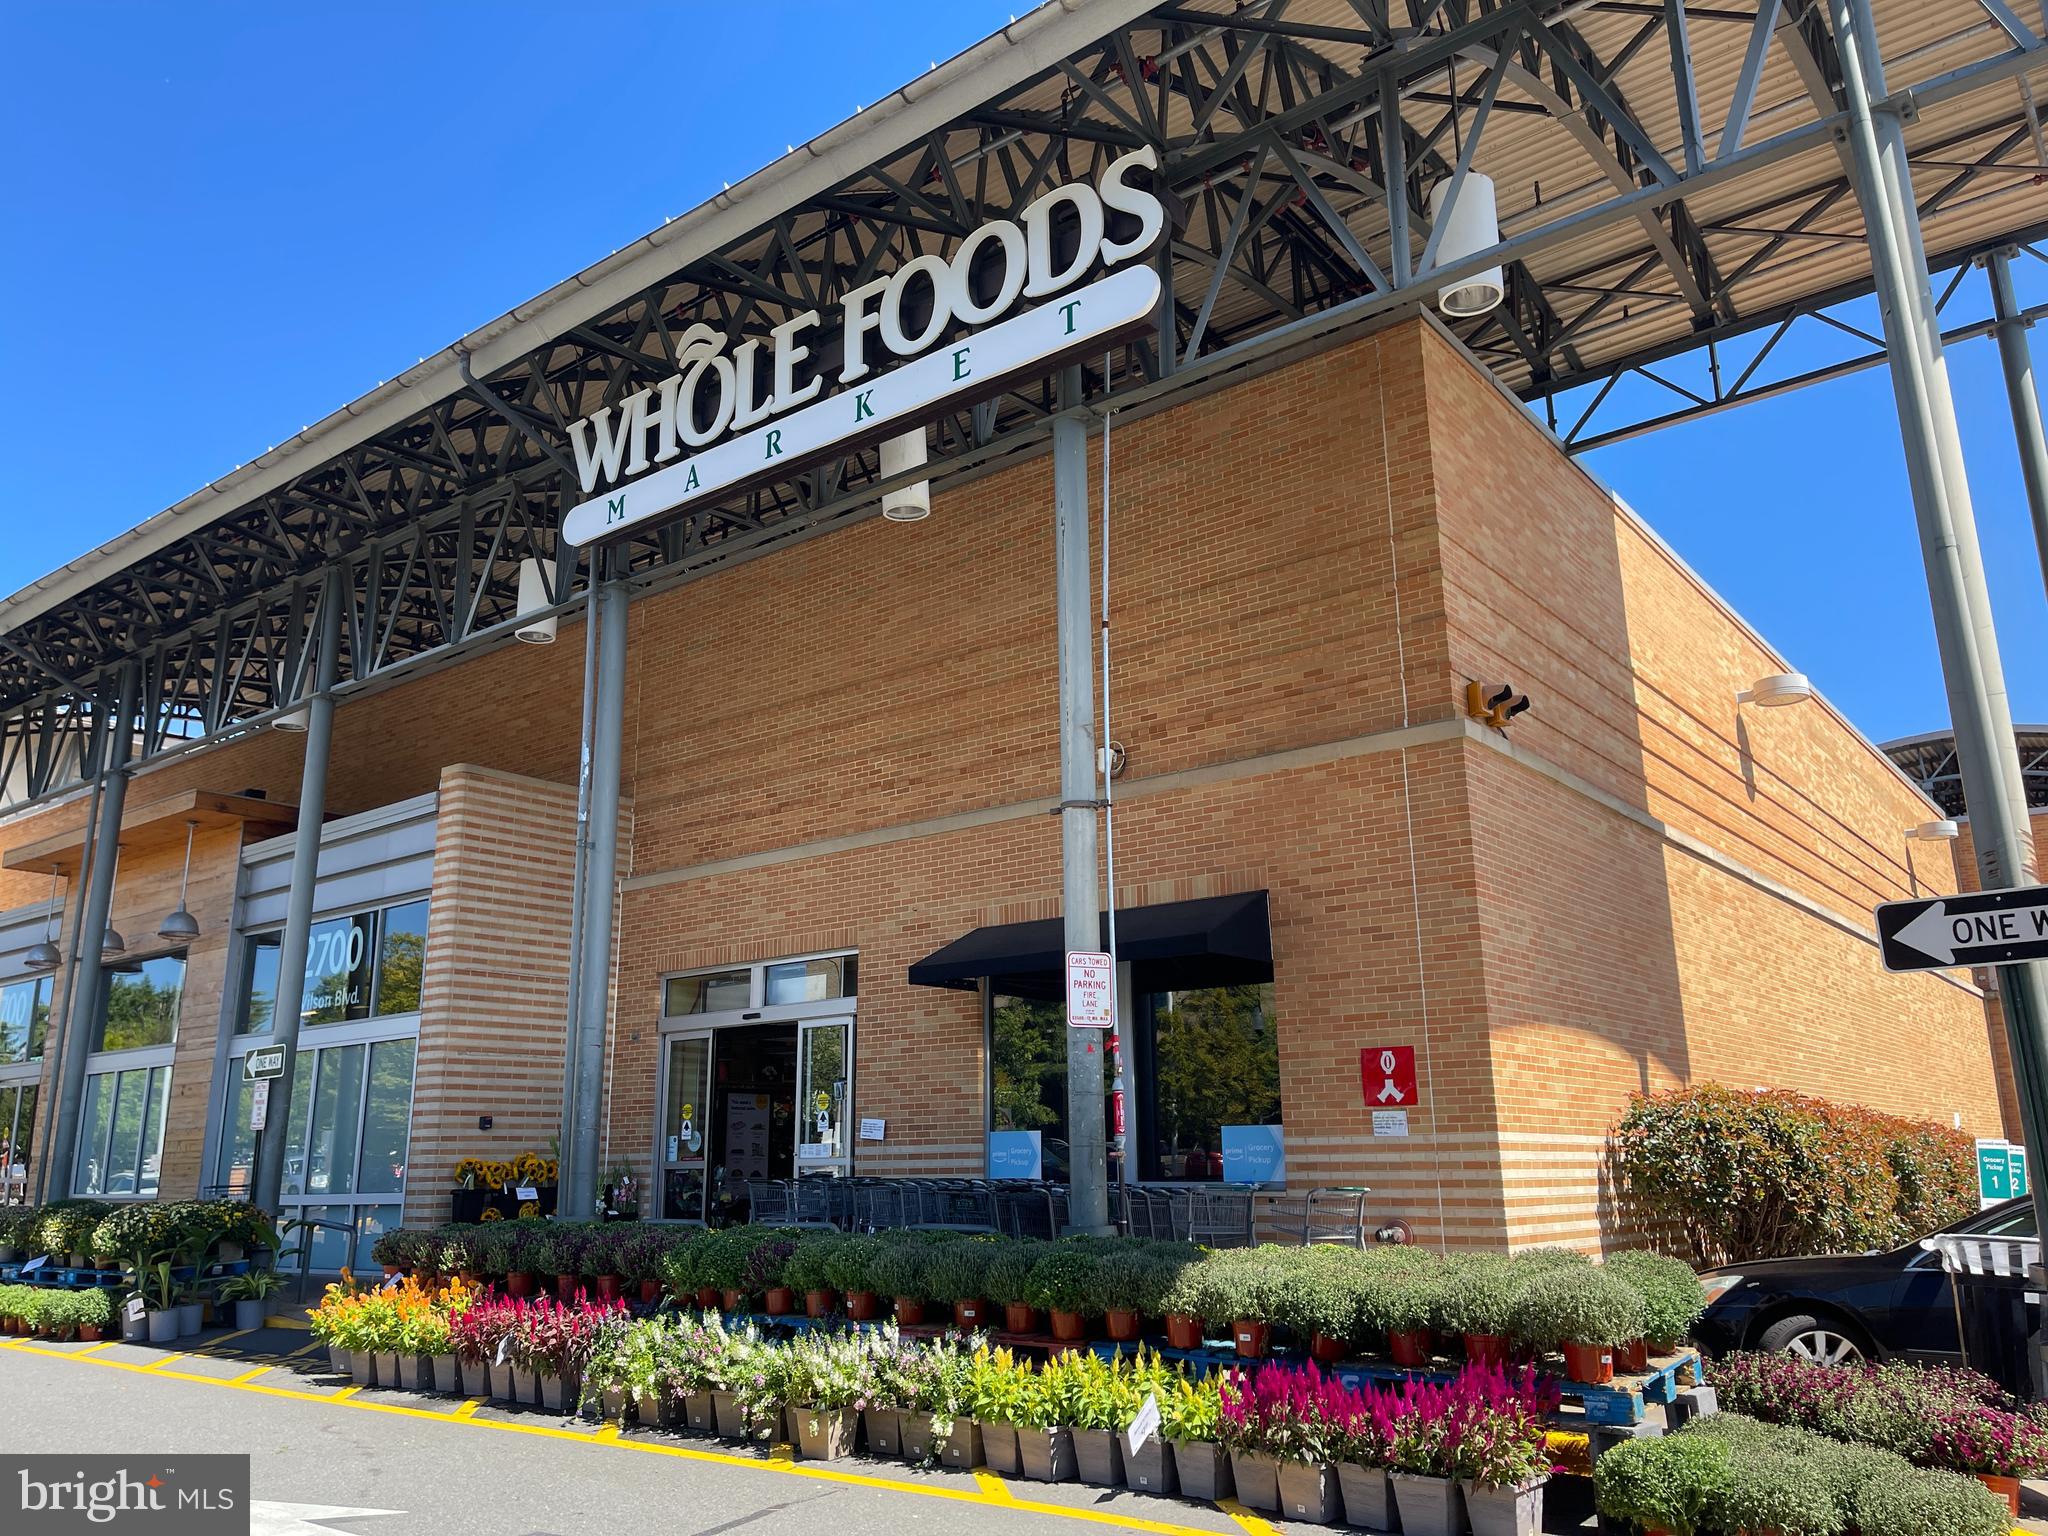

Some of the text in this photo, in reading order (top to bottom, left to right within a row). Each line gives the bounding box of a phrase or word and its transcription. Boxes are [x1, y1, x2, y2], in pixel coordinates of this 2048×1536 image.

[566, 144, 1164, 493] WHOLE FOODS
[606, 300, 1082, 525] MARKET
[1952, 913, 2020, 944] ONE
[304, 926, 364, 978] 2700
[1071, 957, 1108, 966] CARS TOWED
[1083, 969, 1096, 979] NO
[1073, 980, 1106, 990] PARKING
[334, 985, 360, 1007] Blvd.
[1083, 991, 1096, 999] FIRE
[255, 1054, 281, 1069] ONE WAY
[1248, 1144, 1274, 1153] Grocery
[1248, 1156, 1271, 1165] Pickup
[1983, 1156, 2005, 1164] Grocery
[1986, 1163, 2004, 1172] Pickup
[1991, 1175, 1999, 1189] 1
[2012, 1177, 2020, 1190] 2
